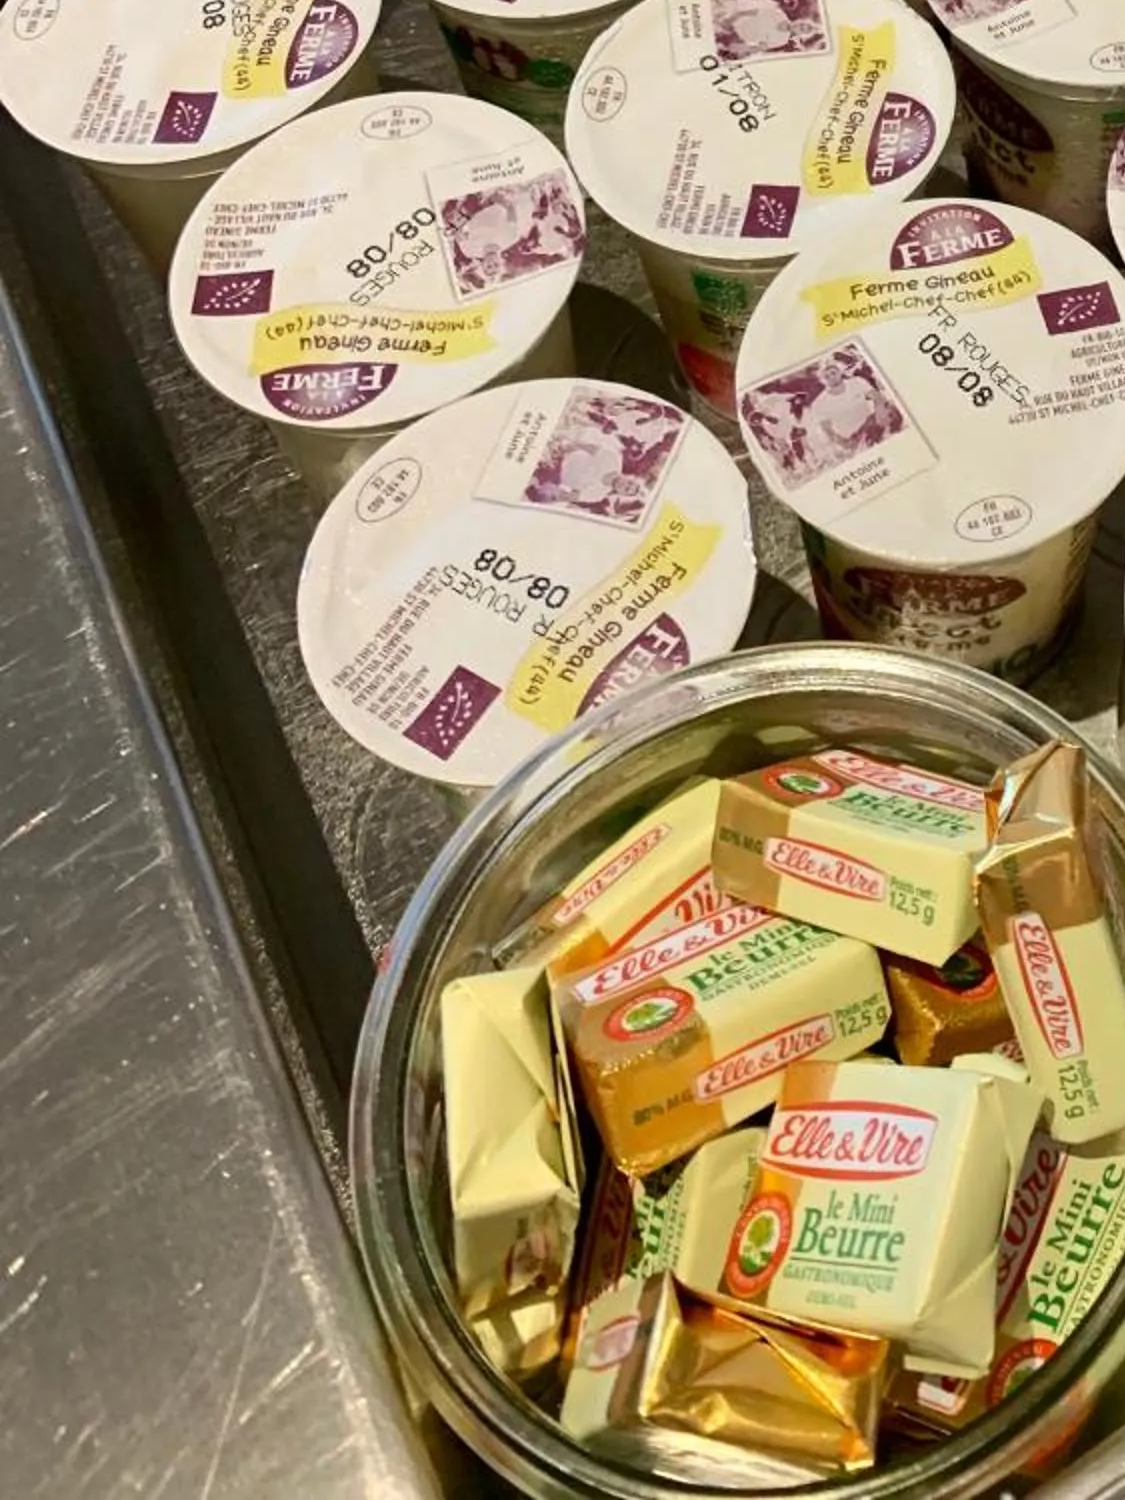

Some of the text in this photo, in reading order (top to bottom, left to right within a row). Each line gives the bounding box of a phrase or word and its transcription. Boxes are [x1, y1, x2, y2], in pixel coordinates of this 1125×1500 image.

[256, 17, 289, 66] Gineau
[291, 4, 338, 82] FERME
[700, 55, 760, 133] 01/08
[837, 59, 886, 164] Ferme Gineau
[873, 100, 910, 179] FERME
[346, 207, 436, 279] 08/08
[898, 228, 1003, 268] FERME
[907, 209, 982, 237] INVITATION
[350, 238, 435, 305] ROUGES
[850, 266, 995, 299] Ferme Gineau
[300, 334, 447, 355] Ferme Gineau
[958, 332, 1032, 402] ROUGES
[271, 365, 385, 390] FERME
[919, 334, 994, 408] 08/08
[516, 414, 549, 464] Antoine
[833, 455, 884, 490] Antoine
[840, 469, 891, 499] et June
[444, 564, 527, 622] ROUGES
[474, 549, 570, 609] 08/08
[559, 561, 687, 684] Ferme Gineau
[846, 791, 978, 832] Beurre
[771, 843, 881, 895] Elle & Vire
[890, 890, 935, 926] 12,5 g
[594, 948, 678, 995] Elle
[710, 952, 732, 966] le
[1017, 918, 1072, 1053] Elle & Vire
[839, 1011, 887, 1038] 12,5 g
[703, 1025, 828, 1094] Elle Vire
[1058, 1064, 1084, 1119] 12,5 g
[771, 1114, 924, 1165] Elle & Vire
[826, 1190, 897, 1223] le Mini
[1006, 1147, 1059, 1248] Vire
[794, 1209, 905, 1262] Beurre
[1029, 1161, 1124, 1330] Beurre
[1032, 1180, 1095, 1290] le Mini
[783, 1265, 896, 1292] GASTRONOMIQUE
